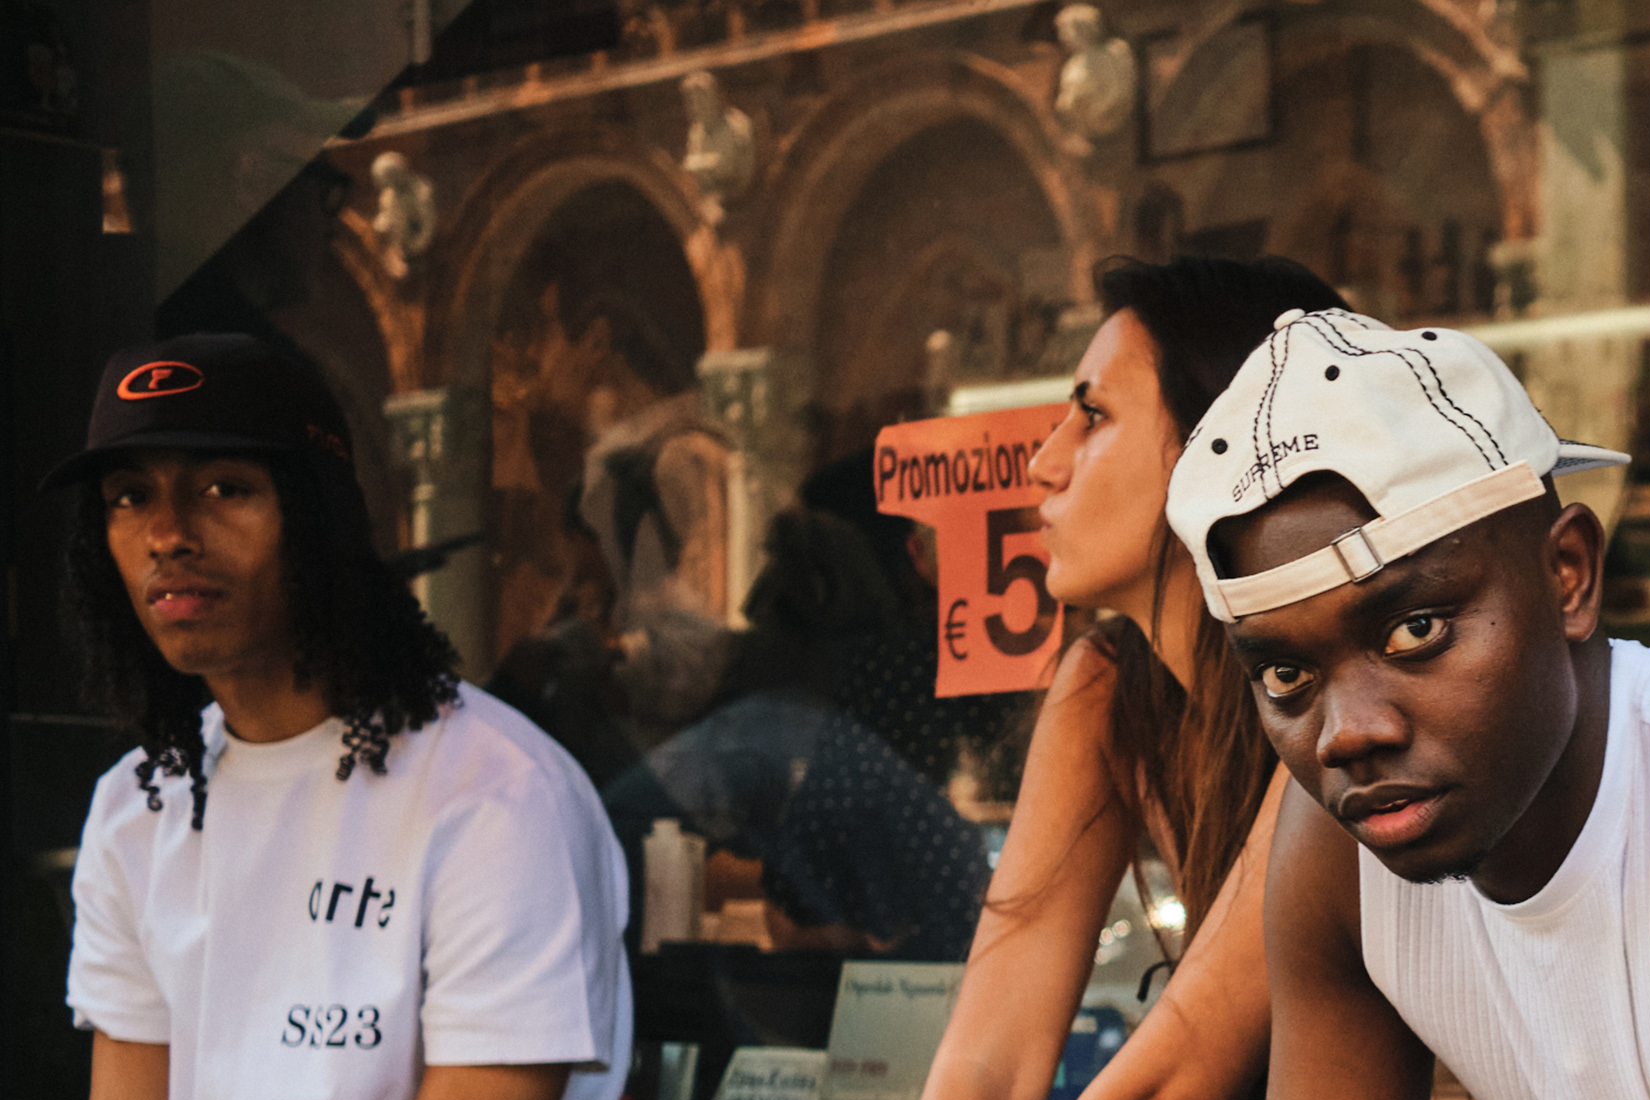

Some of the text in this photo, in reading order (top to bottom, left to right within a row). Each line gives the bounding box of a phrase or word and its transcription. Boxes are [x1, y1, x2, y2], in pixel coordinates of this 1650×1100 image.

[878, 430, 1044, 504] Promozion
[1232, 433, 1319, 502] SUPREME
[984, 505, 1060, 657] 5
[278, 1004, 383, 1049] SS23
